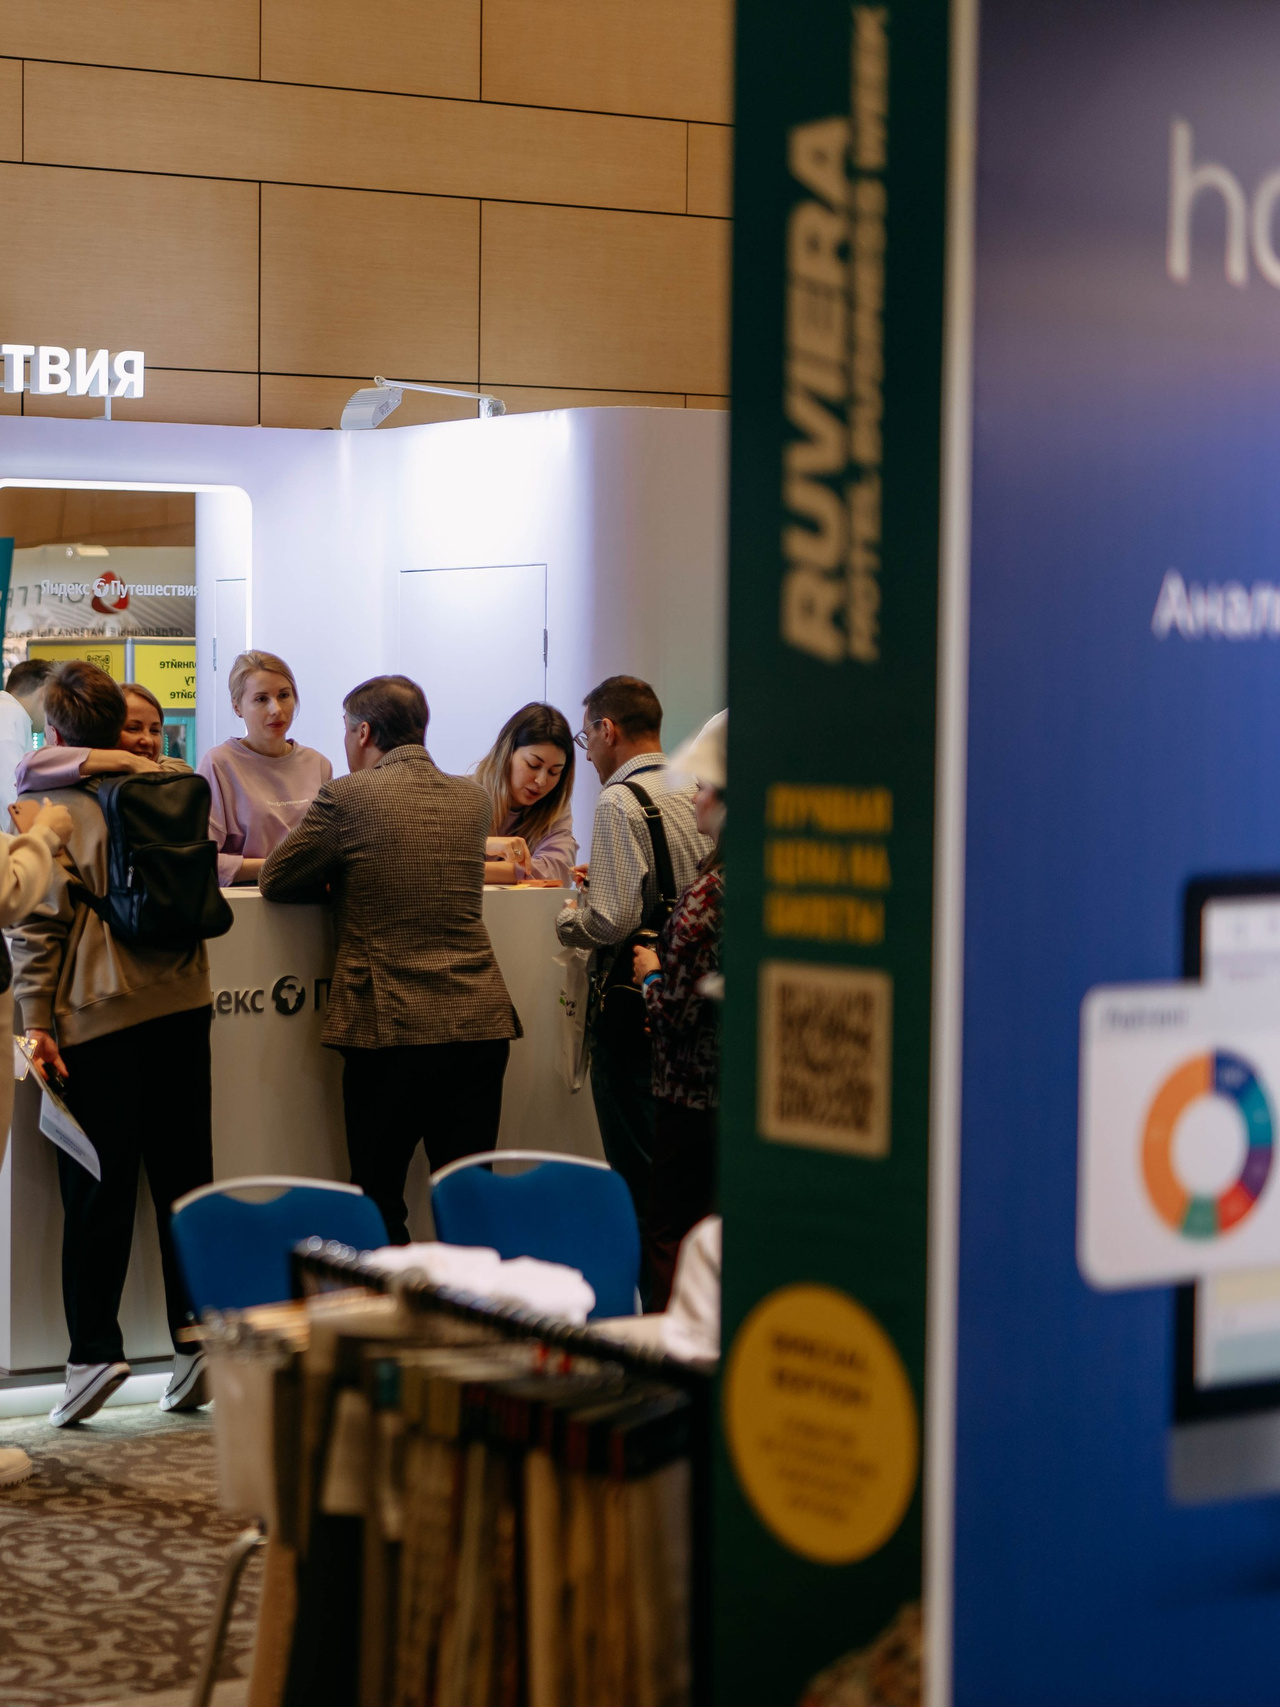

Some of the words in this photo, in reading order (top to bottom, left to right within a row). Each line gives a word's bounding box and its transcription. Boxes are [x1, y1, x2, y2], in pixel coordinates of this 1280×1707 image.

[780, 115, 850, 662] RUVIERA
[41, 579, 90, 597] Яндекс
[110, 580, 199, 599] Путешествия
